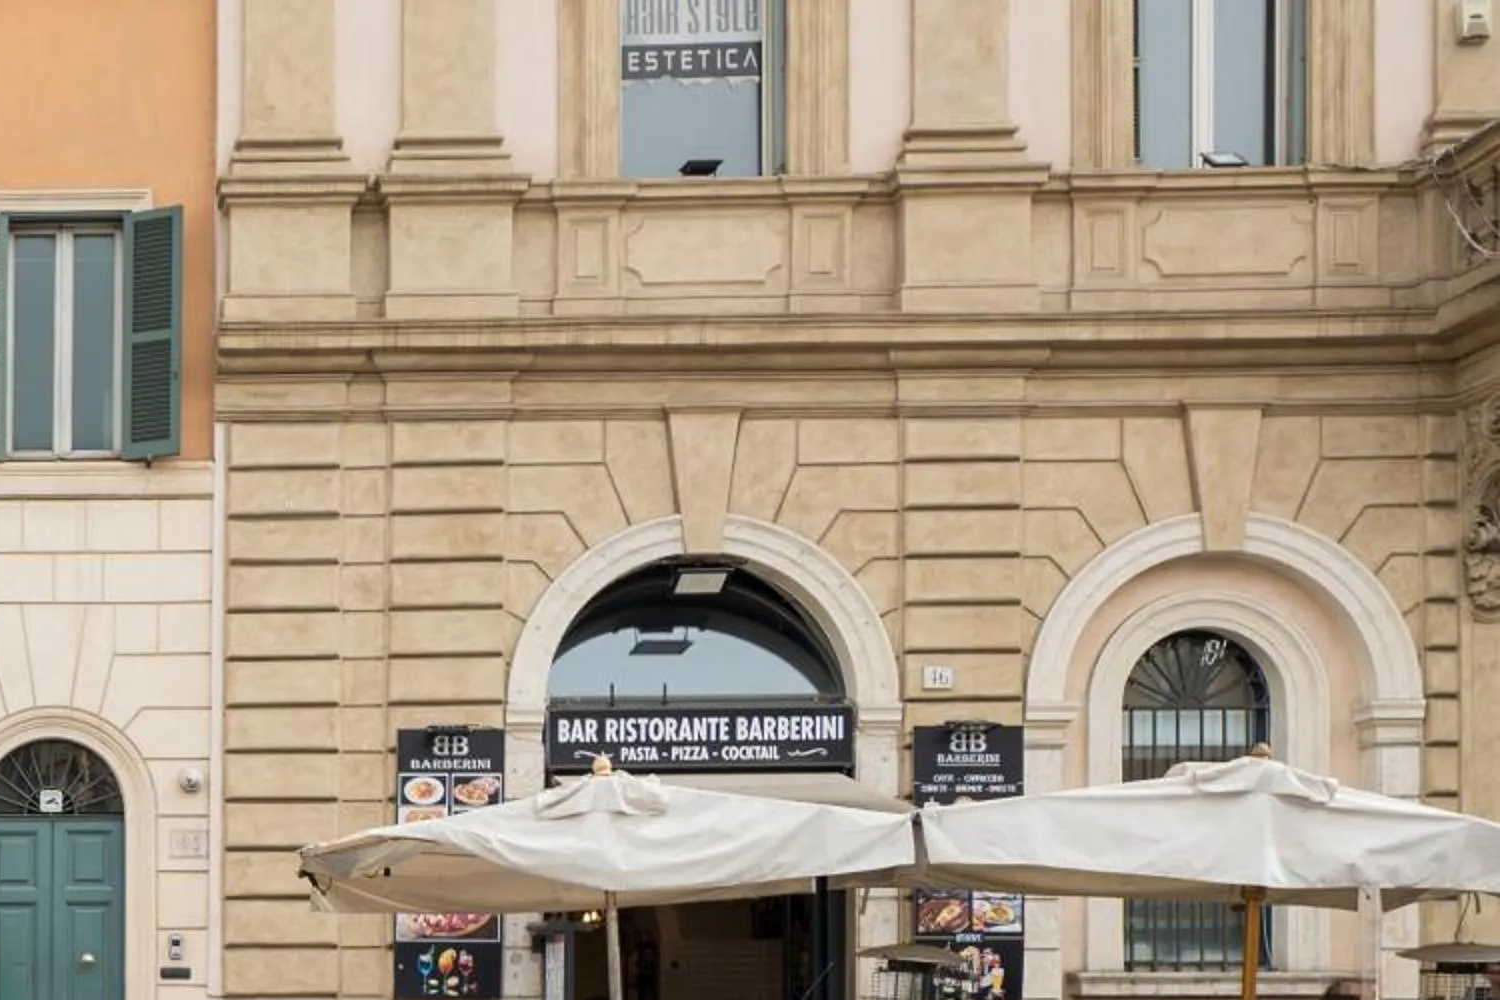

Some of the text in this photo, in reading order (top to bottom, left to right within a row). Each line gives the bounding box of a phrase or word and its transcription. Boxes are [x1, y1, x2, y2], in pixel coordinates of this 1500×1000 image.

[627, 48, 759, 71] ESTETICA
[557, 715, 845, 743] BAR RISTORANTE BARBERINI
[620, 747, 659, 762] PASTA
[671, 746, 709, 761] PIZZA
[722, 745, 781, 761] COCKTAIL
[937, 753, 1001, 763] BARBERINI
[410, 759, 491, 769] BARBERINI
